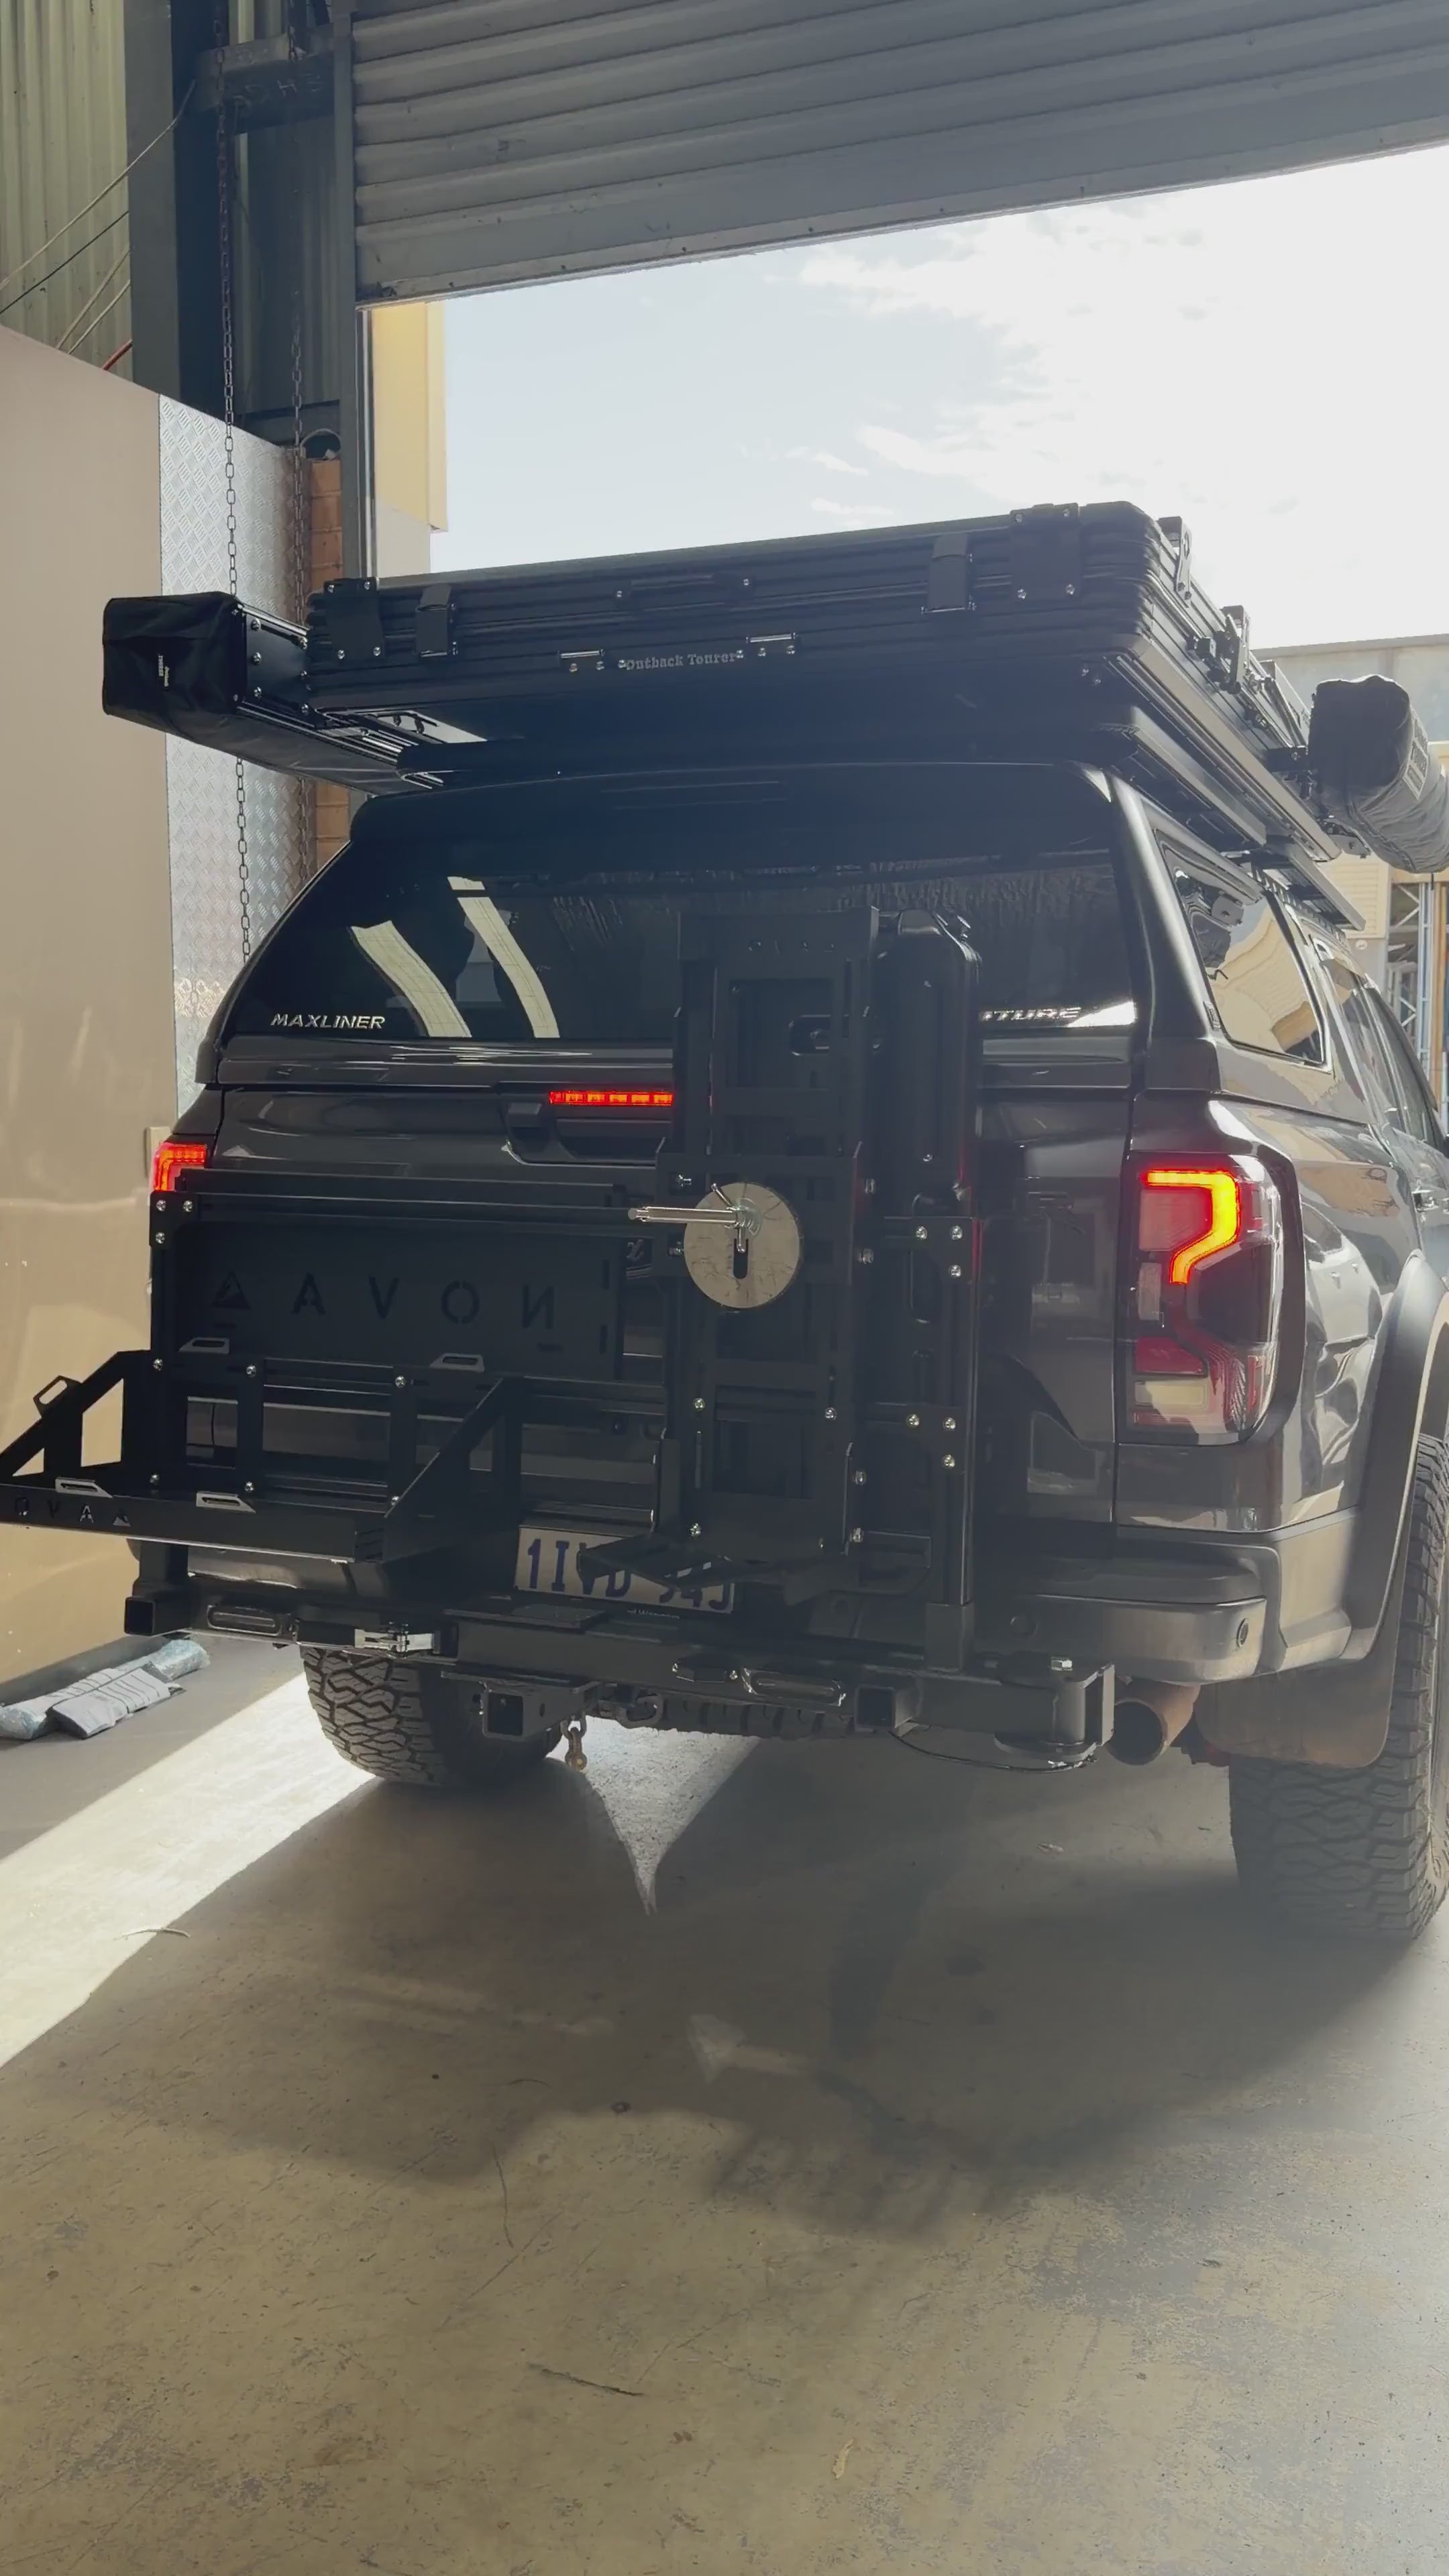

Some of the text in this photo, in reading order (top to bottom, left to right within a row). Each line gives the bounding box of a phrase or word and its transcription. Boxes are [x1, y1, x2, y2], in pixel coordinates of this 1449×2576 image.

[625, 651, 737, 670] Outback Tourer
[270, 1012, 386, 1029] MAXLINER
